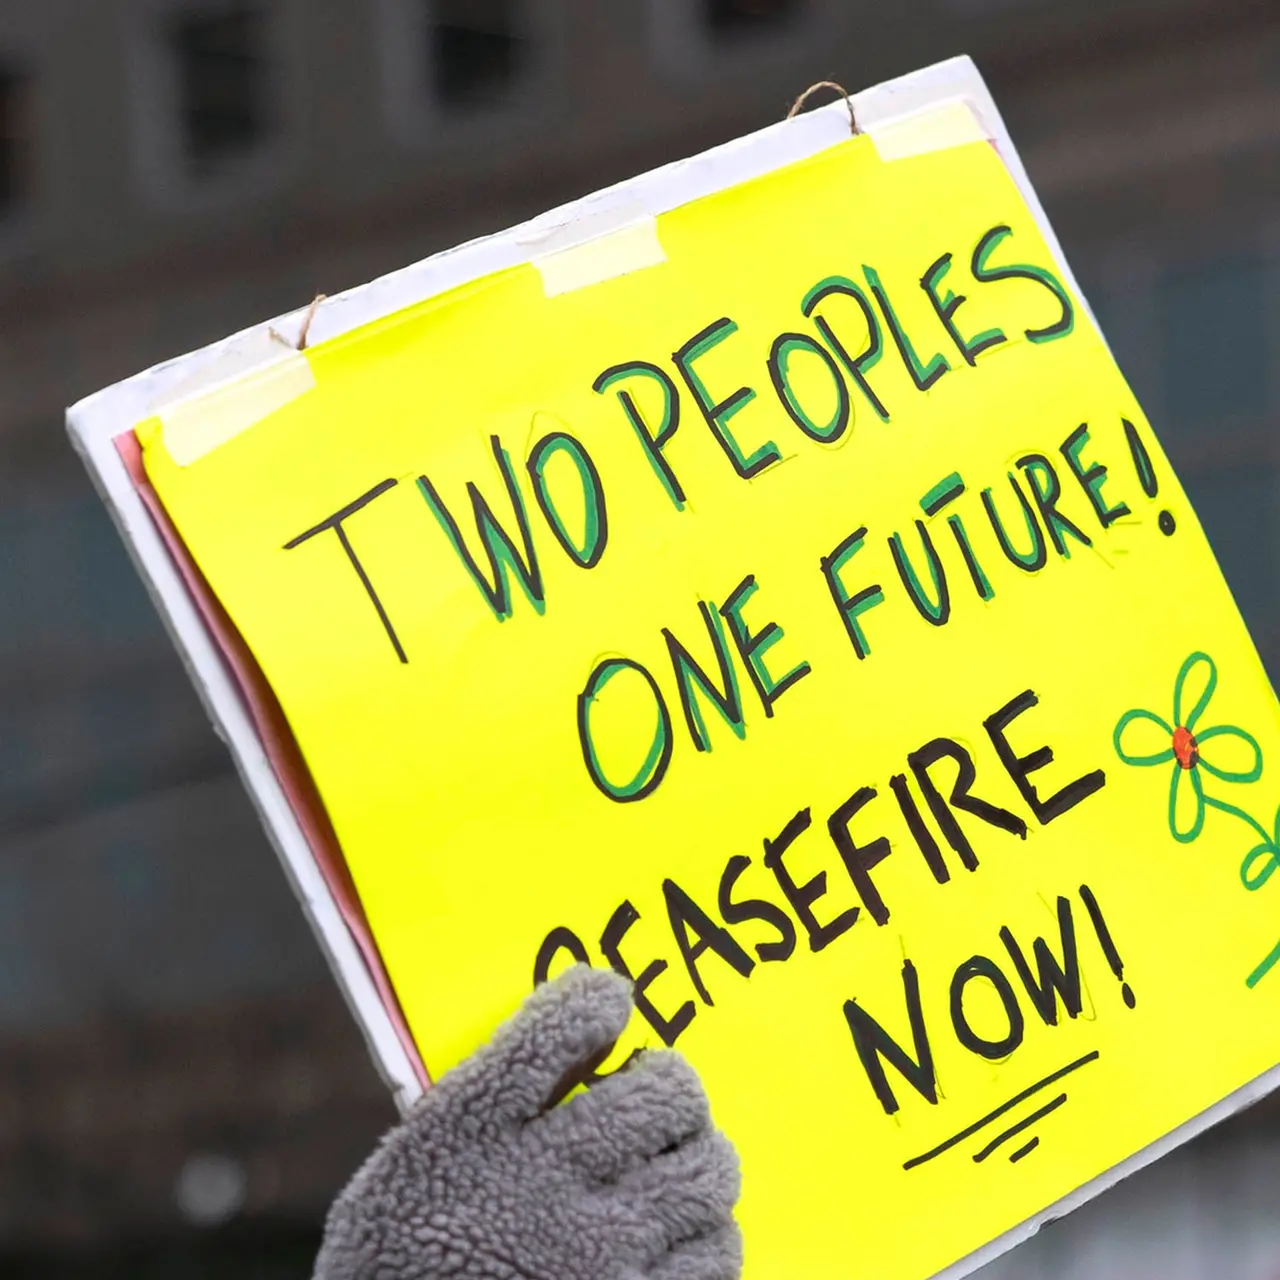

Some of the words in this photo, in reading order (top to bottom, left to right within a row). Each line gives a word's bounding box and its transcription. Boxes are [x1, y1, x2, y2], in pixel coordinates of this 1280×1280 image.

[283, 430, 607, 664] TWO
[593, 225, 1077, 516] PEOPLES
[577, 575, 811, 804] ONE
[820, 417, 1178, 660] FUTURE!
[843, 884, 1136, 1115] NOW!
